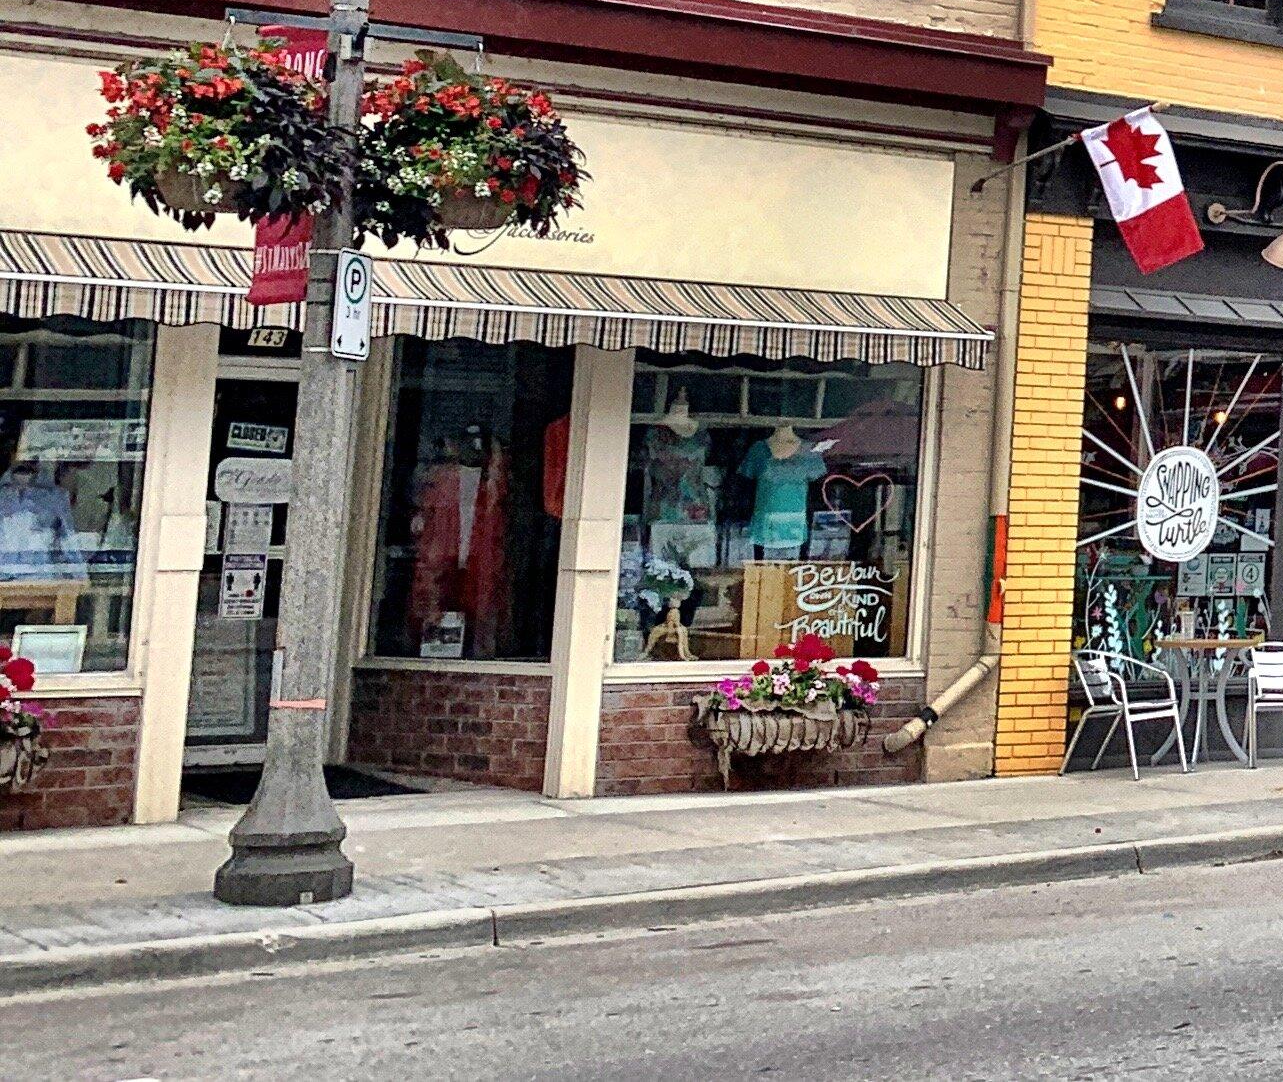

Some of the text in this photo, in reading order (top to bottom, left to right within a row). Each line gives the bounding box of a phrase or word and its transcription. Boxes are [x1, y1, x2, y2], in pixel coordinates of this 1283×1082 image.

[252, 330, 285, 346] 143
[1154, 461, 1211, 509] SNAPPING
[1150, 507, 1207, 548] Turtle
[788, 564, 836, 591] Be
[774, 605, 888, 643] Beautiful
